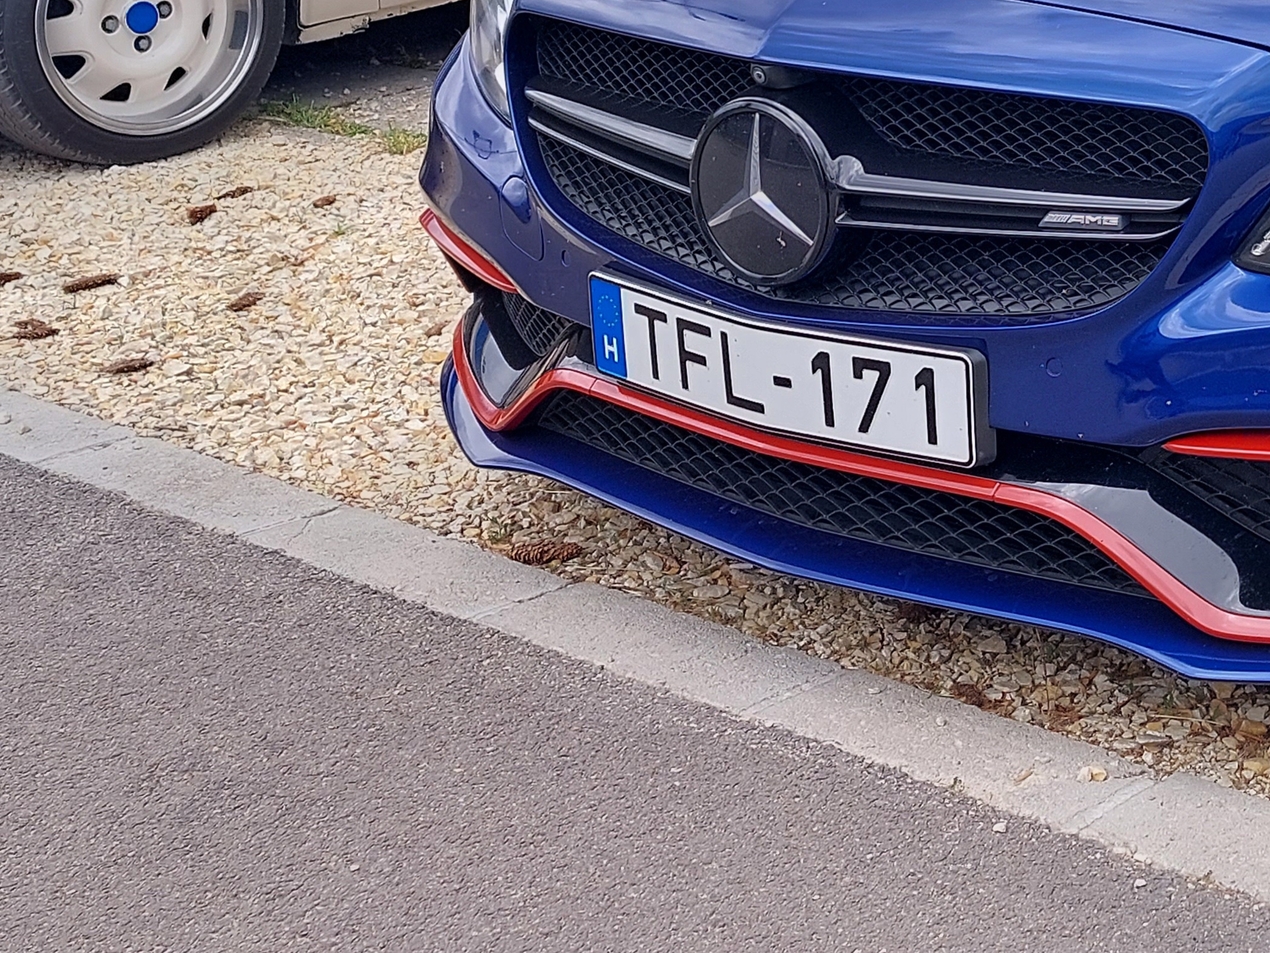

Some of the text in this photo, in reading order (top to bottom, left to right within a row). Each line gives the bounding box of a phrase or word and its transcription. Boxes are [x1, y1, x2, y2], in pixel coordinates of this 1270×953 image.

[1068, 214, 1119, 226] AMG
[602, 334, 618, 363] H
[634, 302, 938, 446] TFL-171
